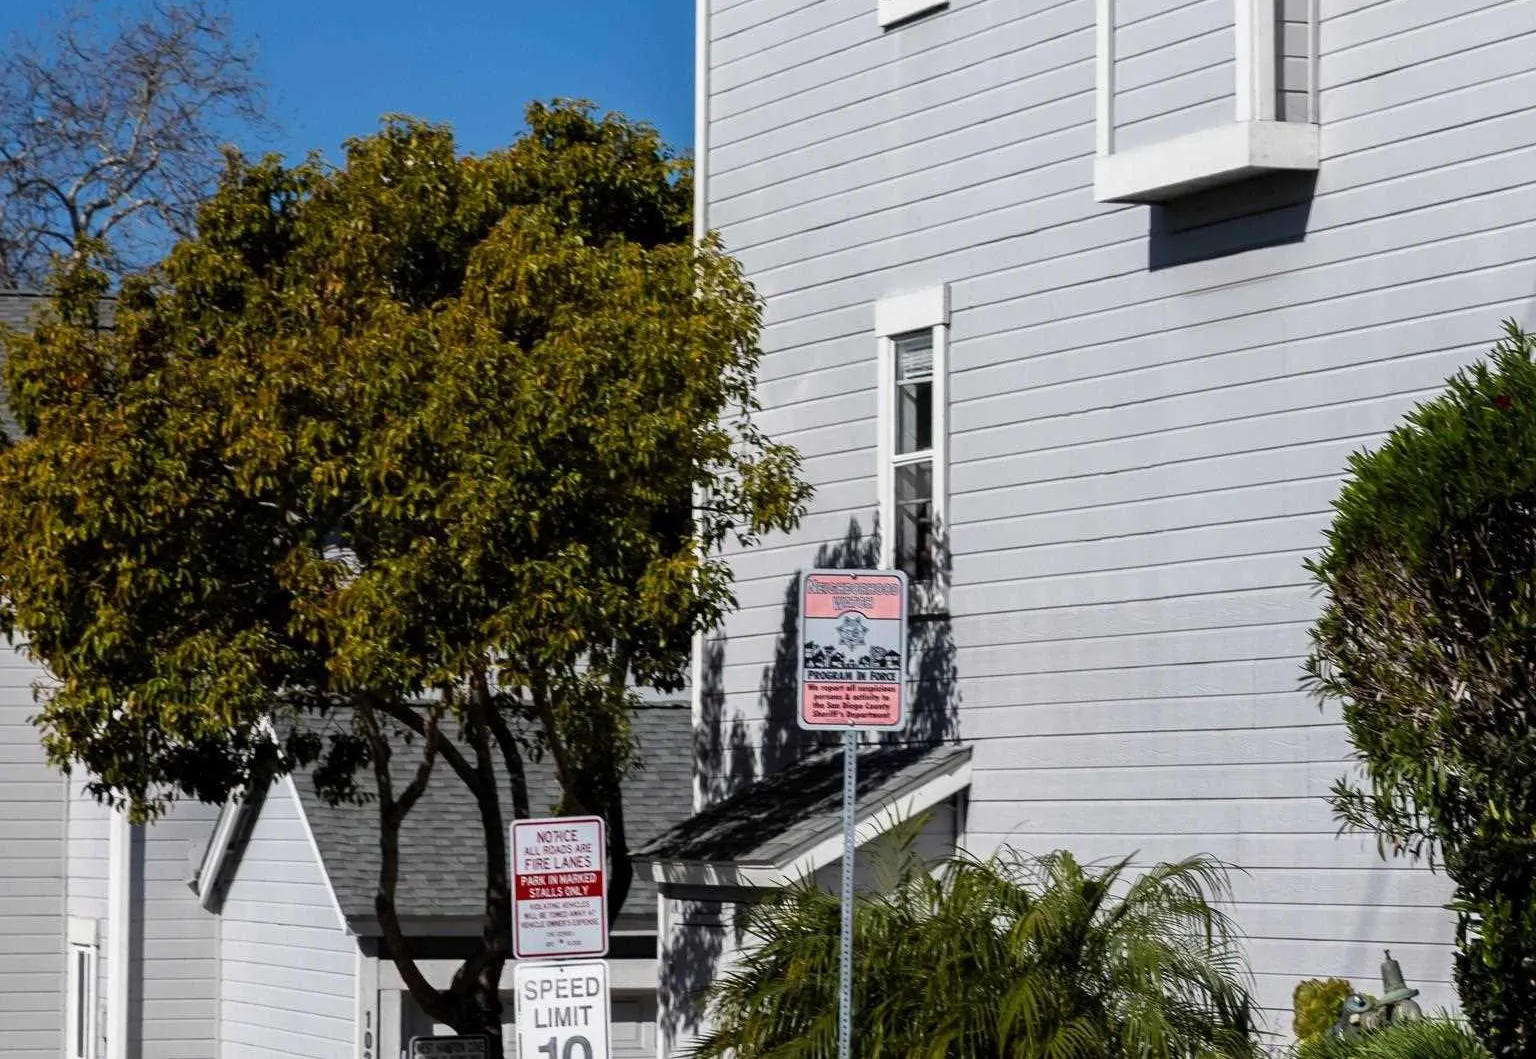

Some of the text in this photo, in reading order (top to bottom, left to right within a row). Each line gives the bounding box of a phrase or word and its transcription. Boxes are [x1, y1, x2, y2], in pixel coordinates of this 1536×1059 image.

[808, 670, 896, 681] PROGRAM IN FORCE
[853, 694, 879, 702] activity
[842, 702, 863, 710] Diego
[865, 702, 890, 710] County
[537, 829, 578, 843] NOTICE
[525, 843, 592, 855] ALL ROADS ARE
[525, 855, 592, 870] FIRE LANES
[520, 872, 597, 887] PARK IN MARKED
[529, 885, 589, 898] STALLS ONLY
[525, 977, 600, 1000] SPEED
[534, 1005, 592, 1028] LIMIT
